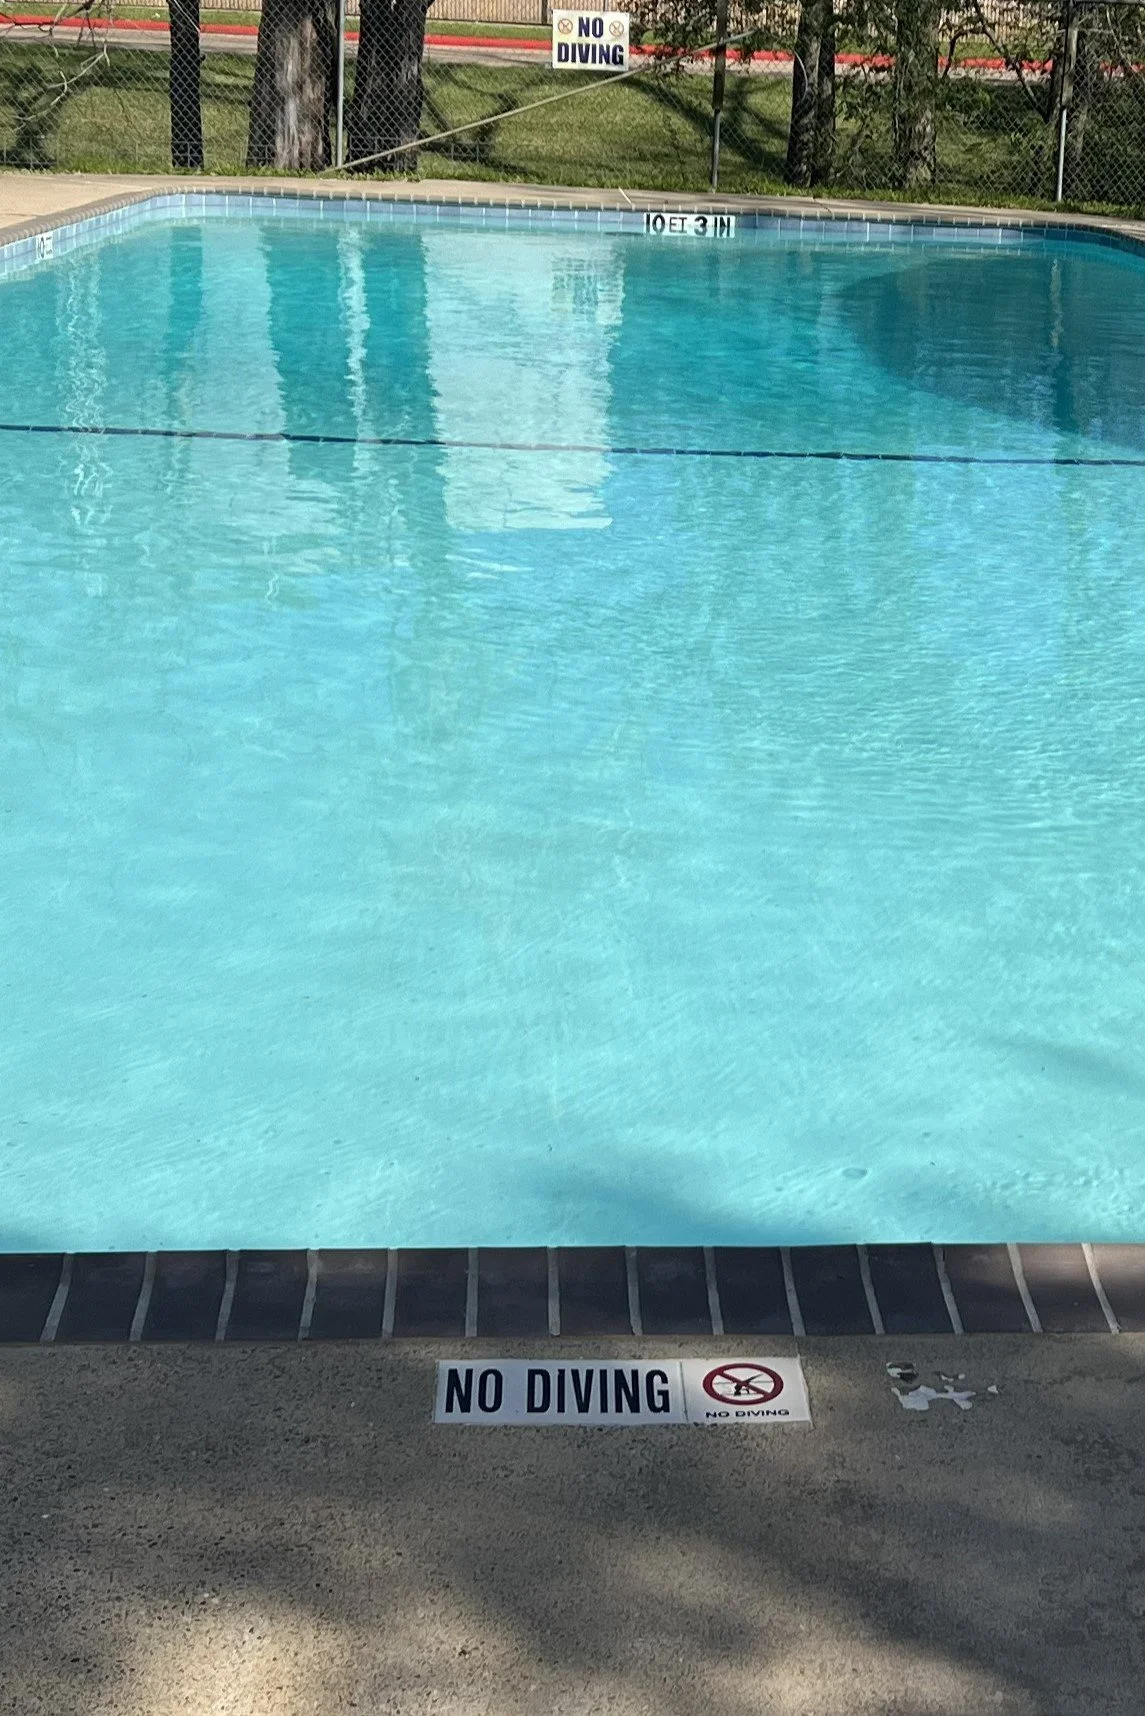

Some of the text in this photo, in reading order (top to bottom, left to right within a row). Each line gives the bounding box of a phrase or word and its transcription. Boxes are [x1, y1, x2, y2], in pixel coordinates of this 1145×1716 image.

[578, 16, 604, 38] NO
[557, 42, 625, 66] DIVING
[645, 213, 666, 232] 10
[694, 215, 708, 233] 3
[714, 216, 731, 233] IN
[444, 1367, 671, 1413] NO DIVING
[705, 1408, 790, 1419] NO DIVING
